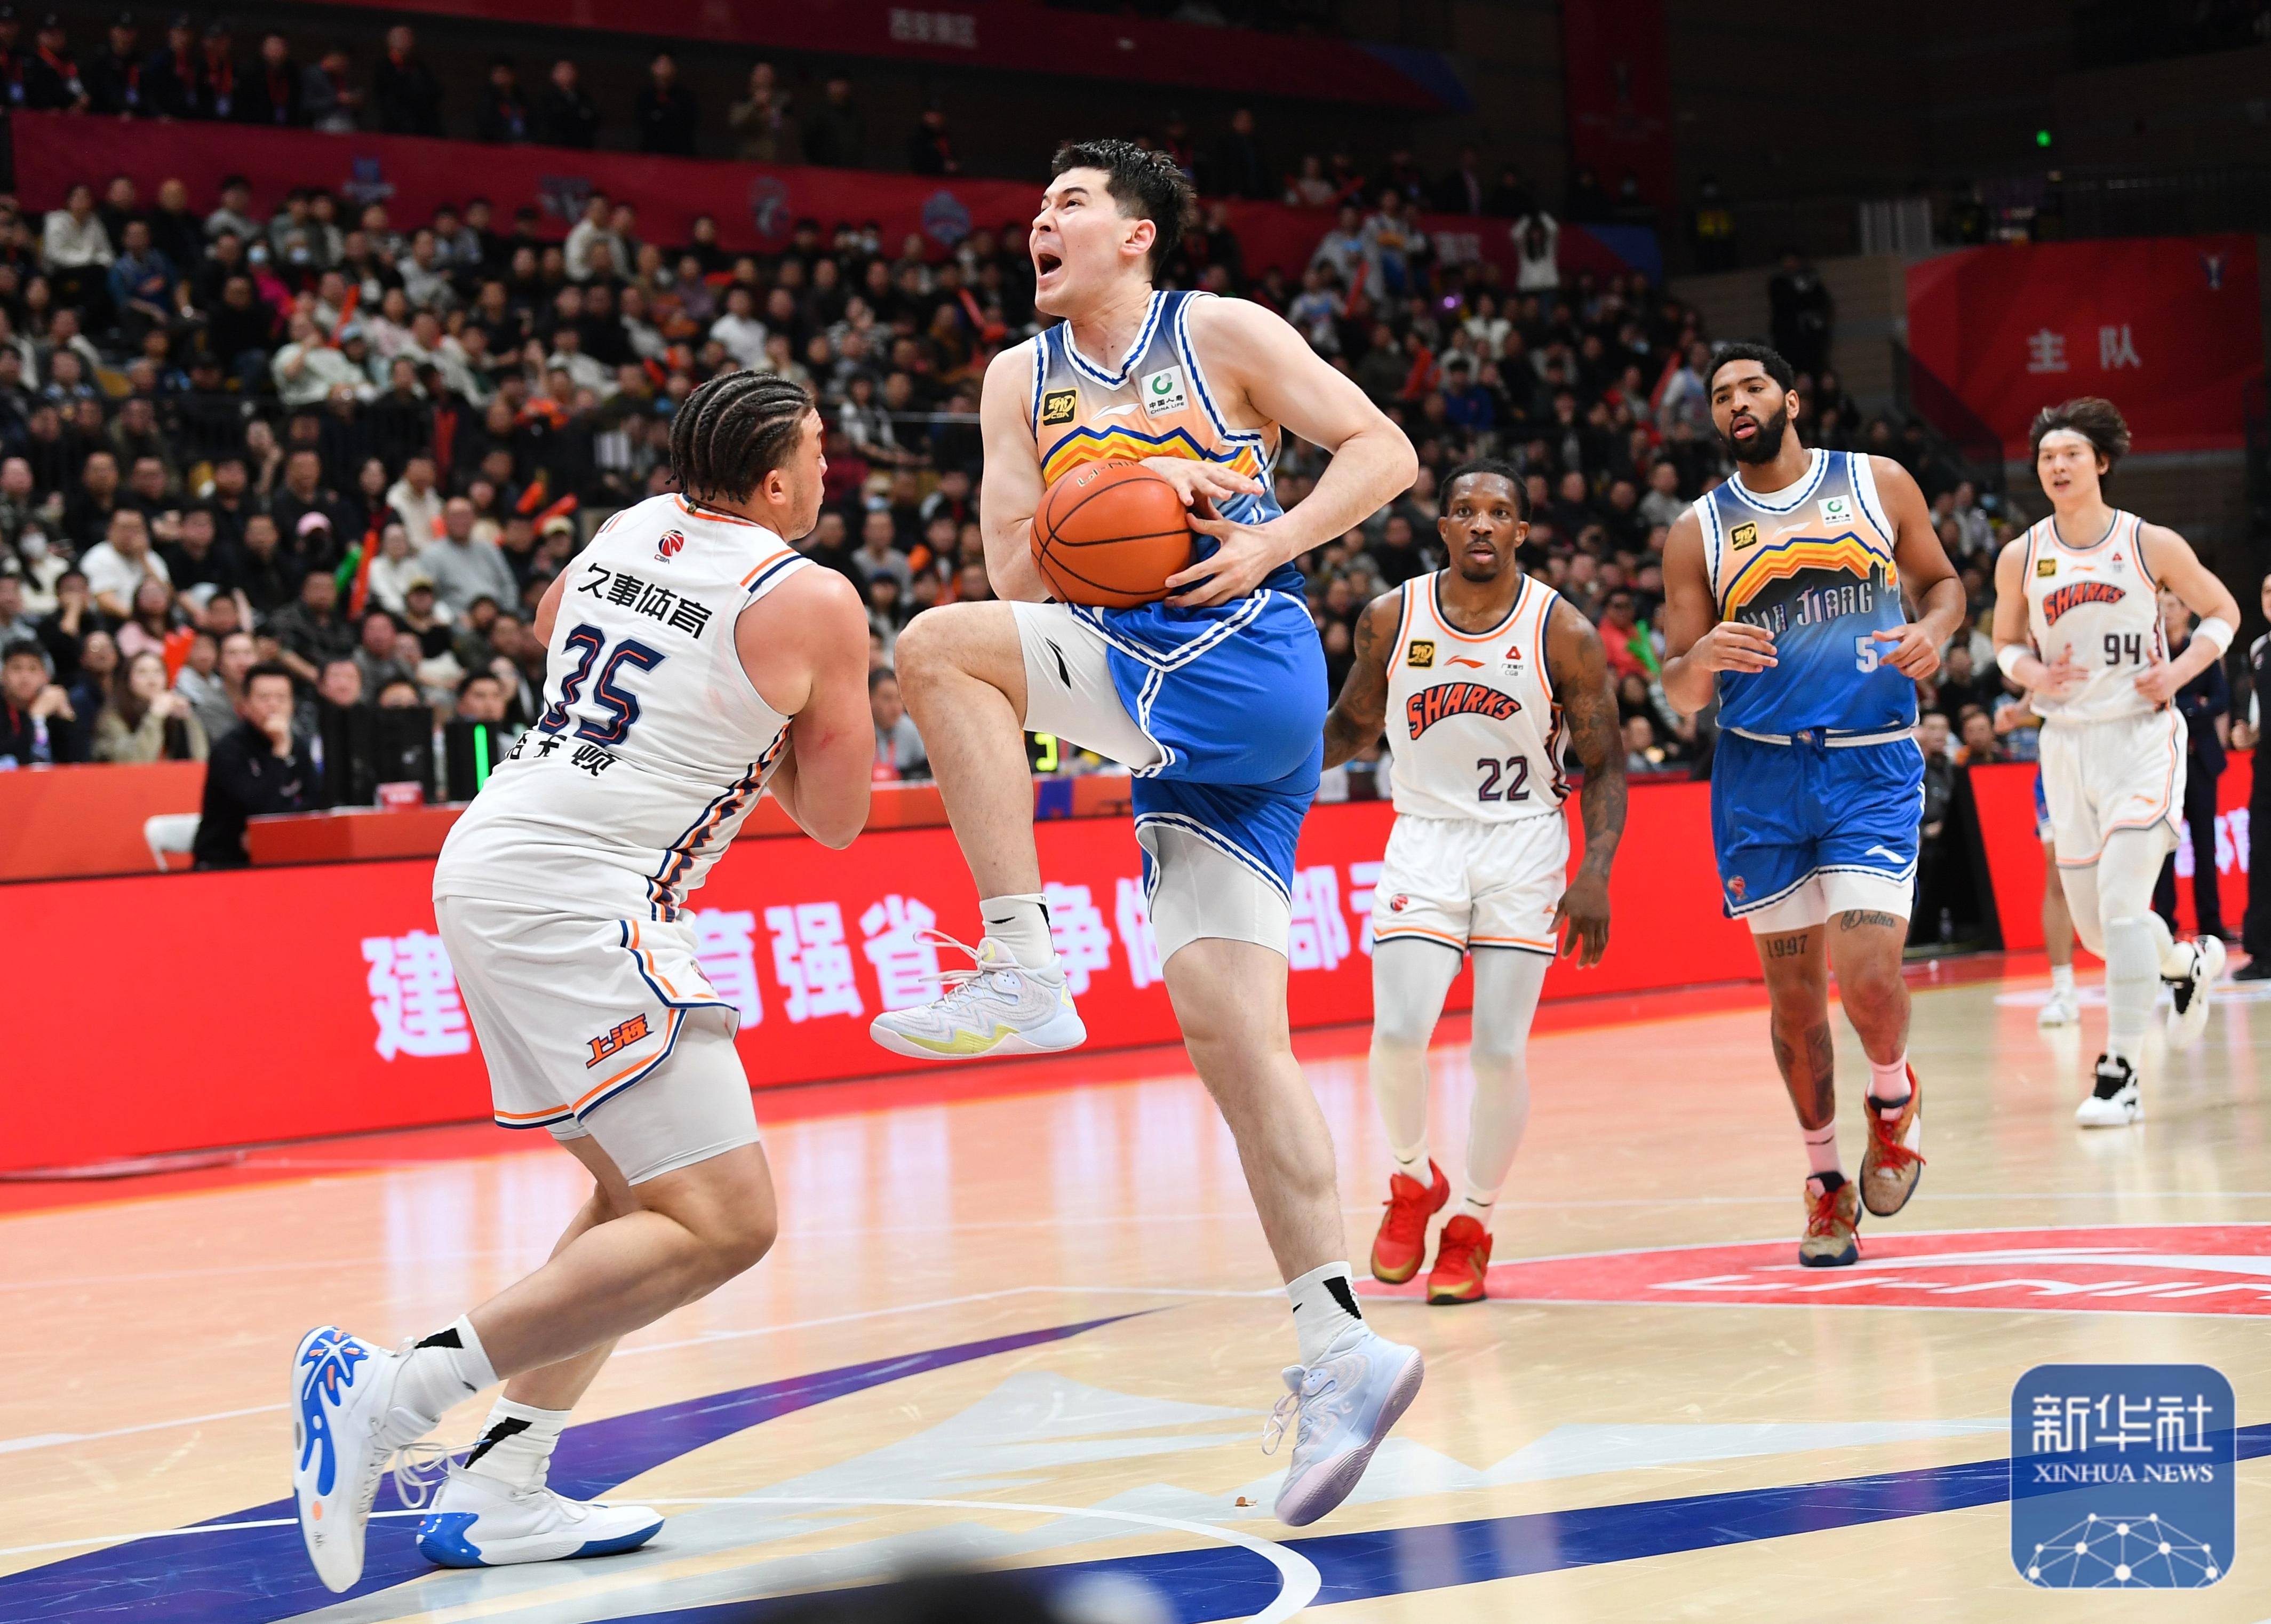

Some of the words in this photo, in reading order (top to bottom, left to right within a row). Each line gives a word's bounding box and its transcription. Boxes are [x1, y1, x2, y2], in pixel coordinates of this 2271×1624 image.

[2026, 323, 2141, 374] 主队
[1149, 394, 1183, 409] 中国人寿
[1150, 406, 1169, 414] CHINA
[577, 562, 713, 639] 久事体育
[2043, 581, 2126, 626] SHARKS
[1855, 635, 1881, 673] 5
[2103, 633, 2141, 666] 94
[1406, 682, 1521, 741] SHARKS
[1477, 755, 1530, 802] 22
[1766, 935, 1808, 959] 1997
[586, 1013, 654, 1070] 上海
